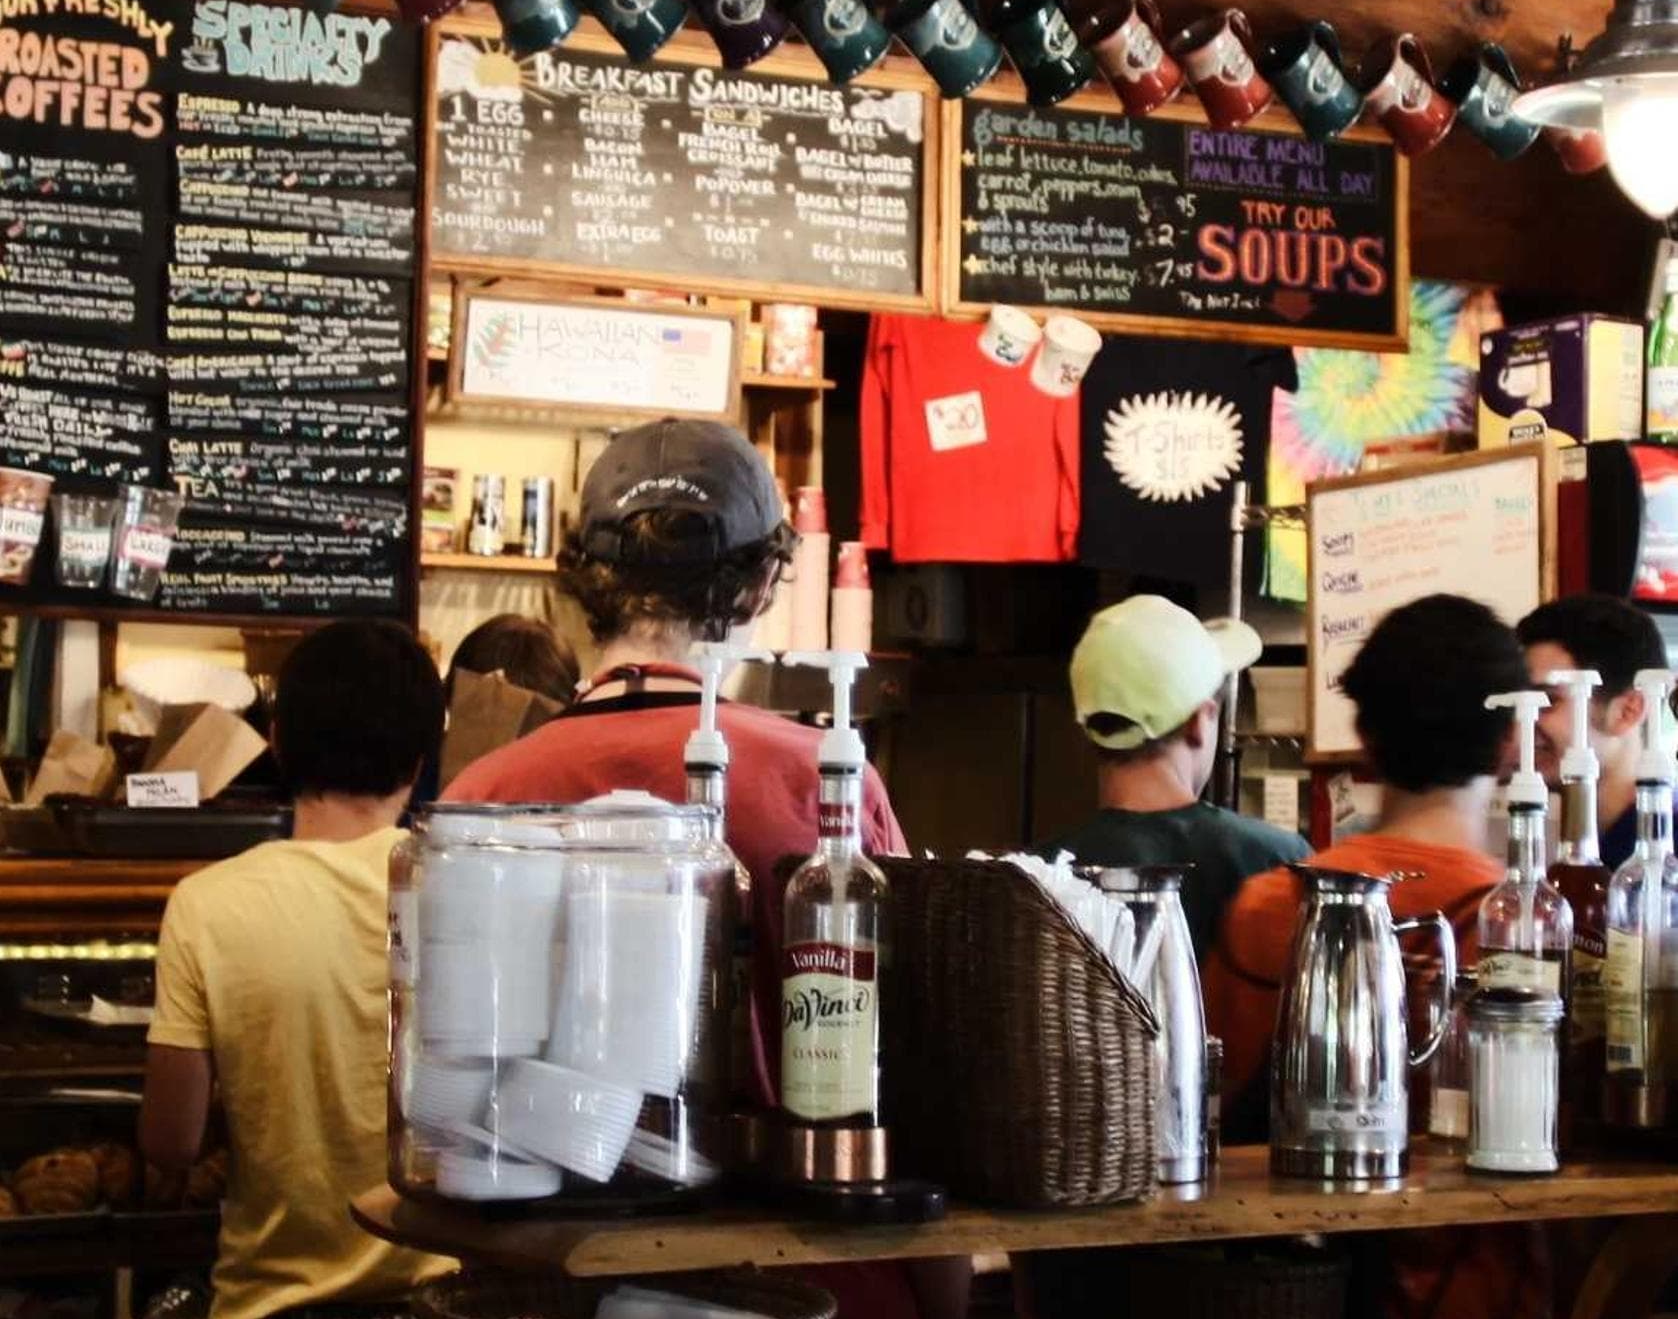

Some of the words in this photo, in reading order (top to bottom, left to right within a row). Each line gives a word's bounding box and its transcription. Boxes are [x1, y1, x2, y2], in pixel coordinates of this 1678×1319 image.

[0, 27, 150, 89] ROASTED
[223, 39, 363, 86] DRINKS
[535, 51, 684, 95] BREAKFAST
[690, 68, 844, 113] SANDWICHES
[0, 77, 164, 139] OFFEES
[450, 95, 467, 121] 1
[477, 99, 525, 125] EGG
[579, 109, 644, 127] CHEESE
[468, 123, 533, 141] TOASTED
[828, 116, 887, 139] BAGEL
[974, 109, 1057, 146] garden
[1067, 116, 1144, 152] salads
[212, 146, 253, 161] LATTE
[584, 138, 644, 156] BACON
[678, 131, 742, 153] FRENCH
[1189, 130, 1258, 160] ENTIRE
[1266, 138, 1326, 167] MENU
[590, 155, 637, 170] HAM
[795, 146, 848, 166] BAGEL
[978, 145, 1014, 167] leaf
[1190, 160, 1283, 188] AVAILABLE
[1297, 171, 1329, 193] ALL
[1340, 173, 1375, 195] DAY
[571, 191, 652, 210] SAUSAGE
[795, 191, 842, 212] BAGEL
[432, 207, 545, 237] SOURDOUGH
[1240, 200, 1286, 225] TRY
[1294, 206, 1336, 229] OUR
[576, 222, 630, 242] EXTRA
[631, 226, 662, 244] EGG
[703, 223, 761, 245] TOAST
[1080, 217, 1095, 237] of
[812, 243, 845, 264] EGG
[1198, 222, 1387, 297] SOUPS
[977, 253, 1017, 274] chef
[1022, 255, 1059, 283] style
[1063, 259, 1092, 275] with
[519, 311, 661, 346] HAWAIIAN
[535, 342, 641, 366] KONA
[203, 440, 242, 454] LATTE
[173, 476, 219, 499] TEA
[792, 950, 847, 971] Vanilla
[783, 987, 870, 1031] DaVinci
